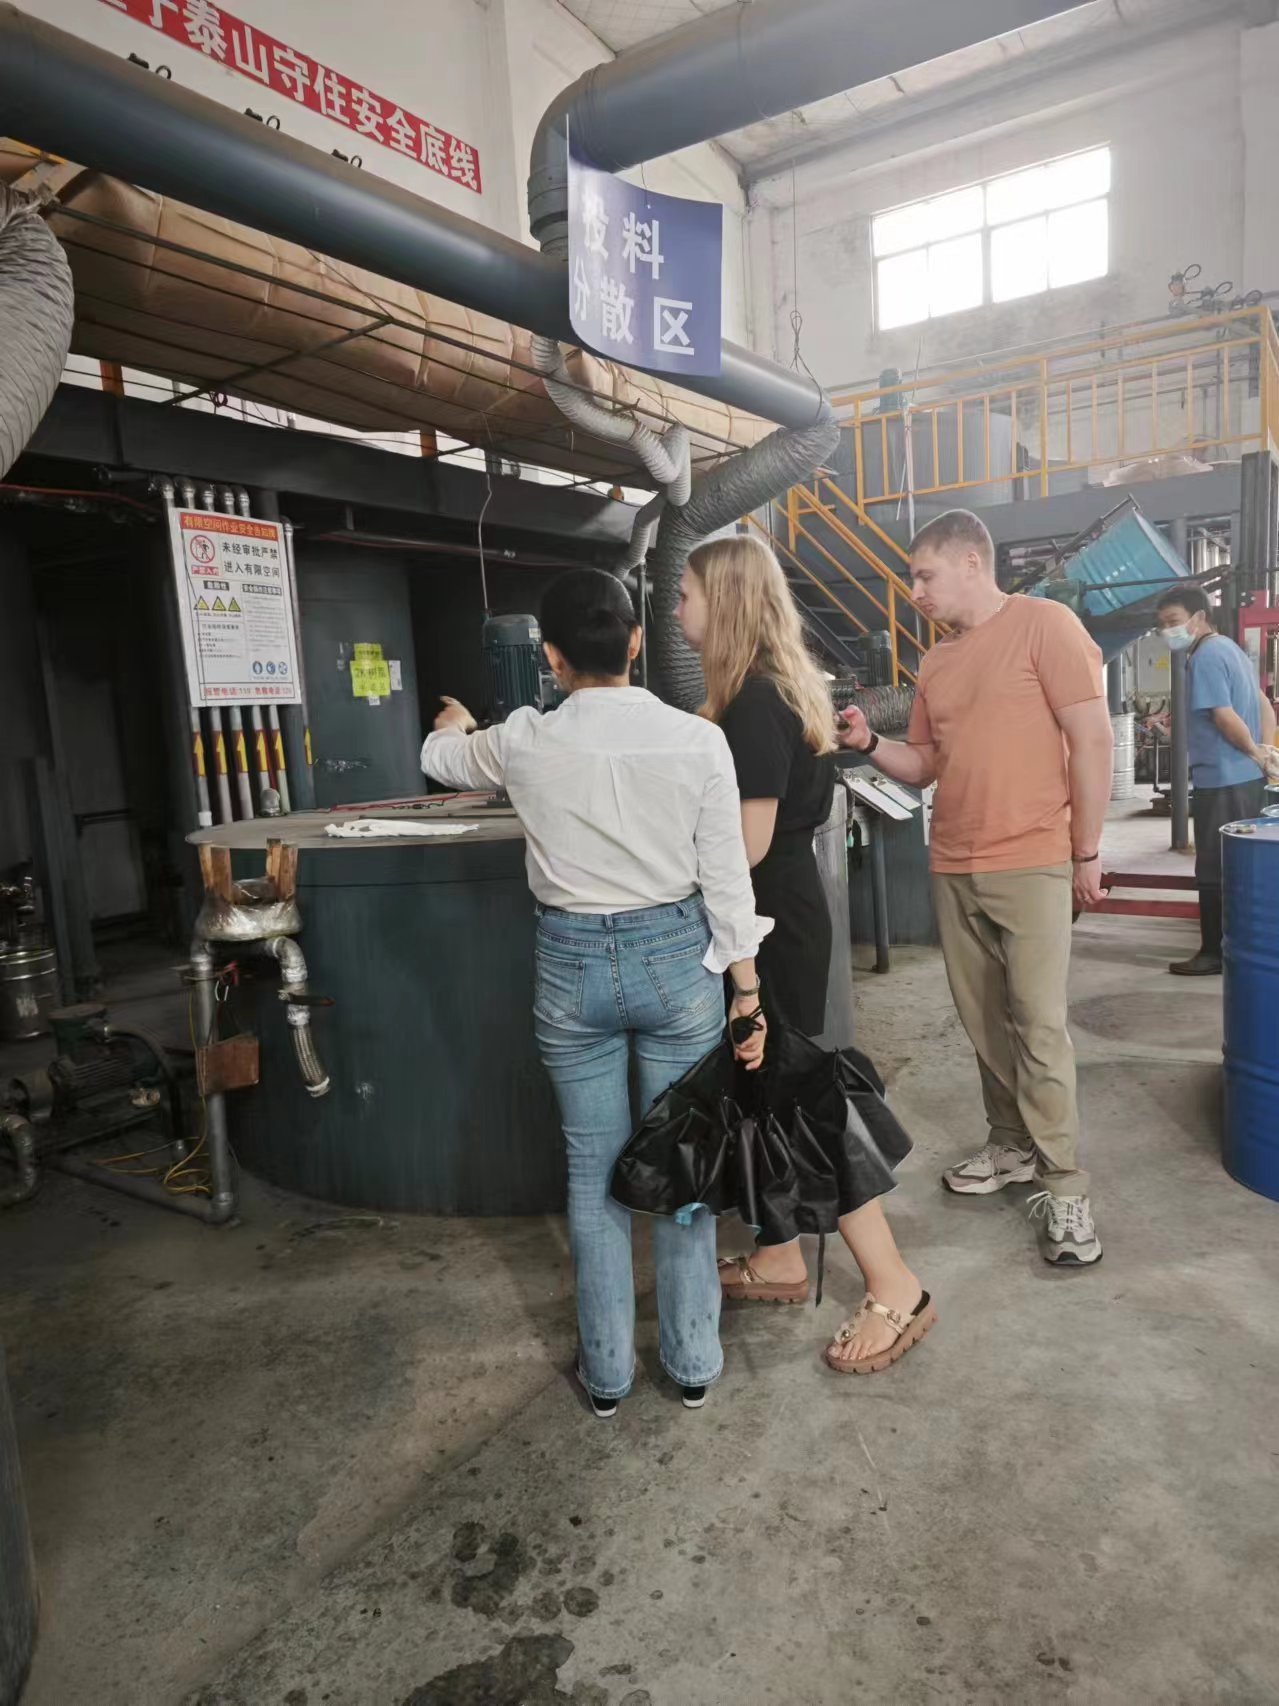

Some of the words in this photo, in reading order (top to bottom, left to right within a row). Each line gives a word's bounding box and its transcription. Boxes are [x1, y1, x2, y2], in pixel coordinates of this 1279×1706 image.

[104, 0, 478, 190] 于泰山守住安全底线
[581, 192, 665, 280] 投料
[573, 255, 695, 356] 分散区
[222, 541, 278, 559] 未经审批严禁
[223, 560, 280, 578] 进入有限空间
